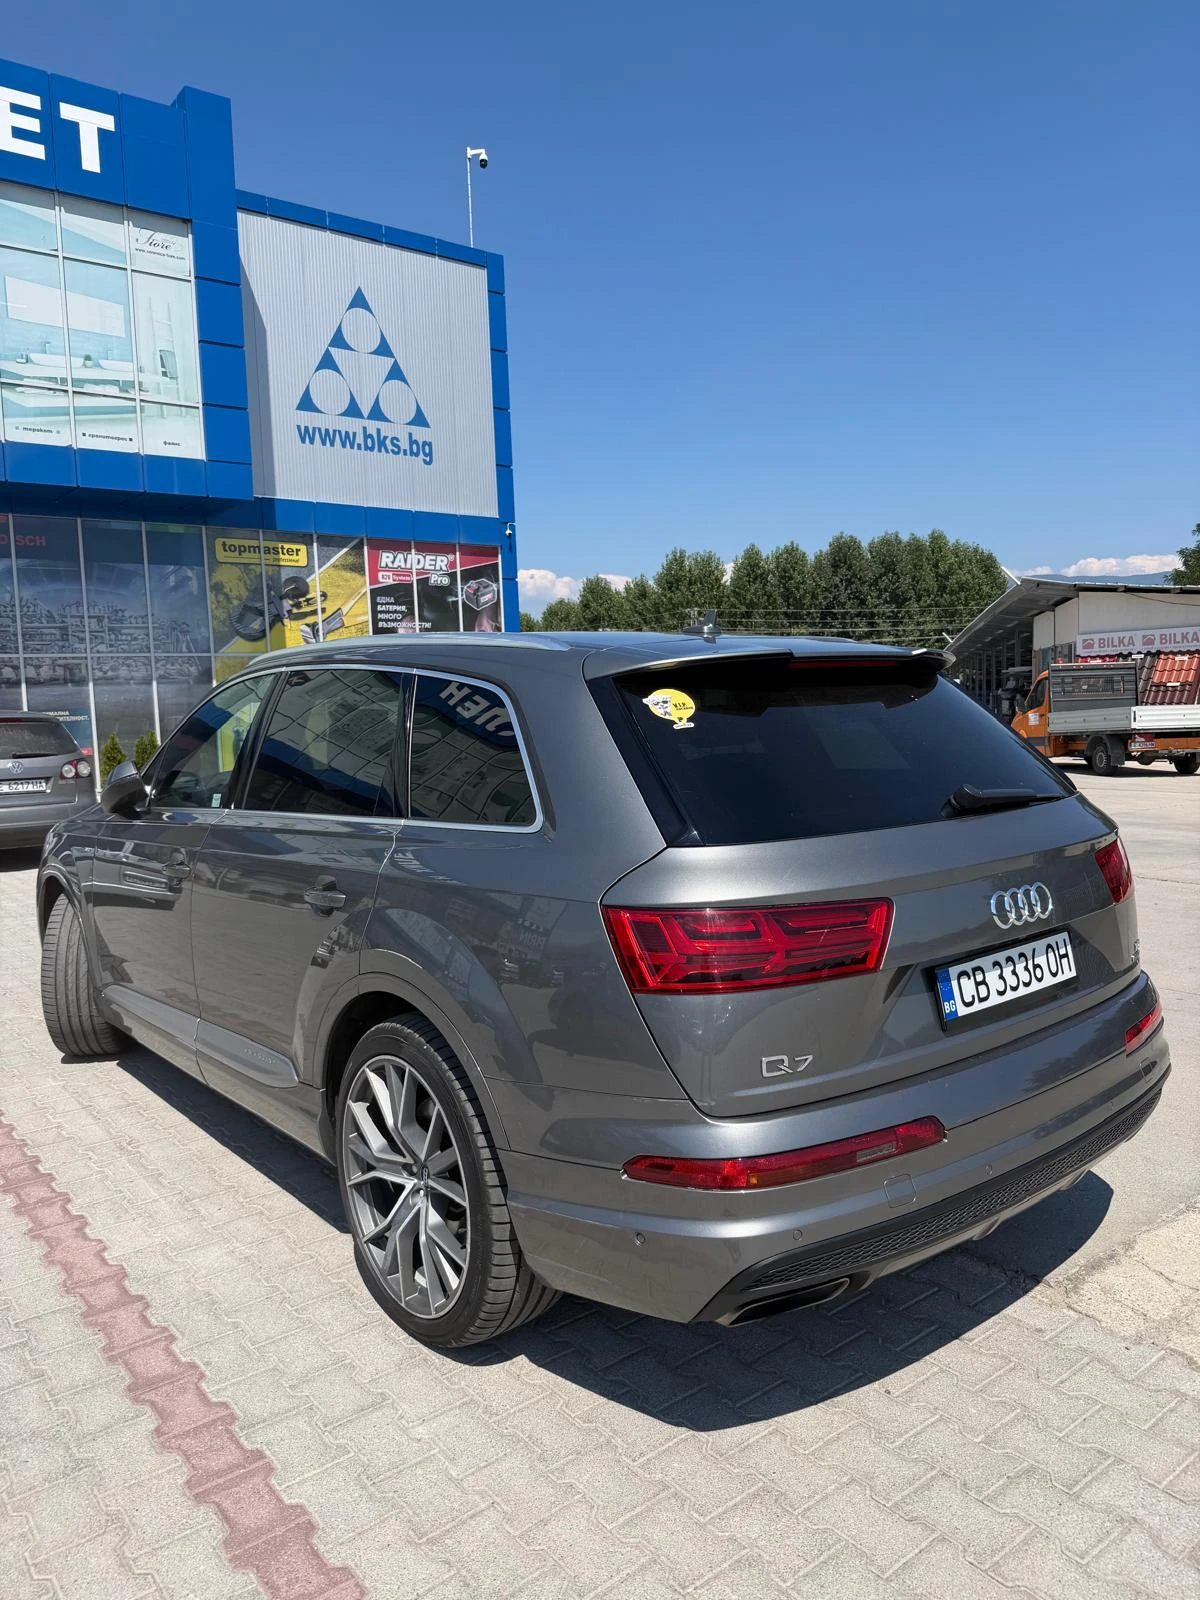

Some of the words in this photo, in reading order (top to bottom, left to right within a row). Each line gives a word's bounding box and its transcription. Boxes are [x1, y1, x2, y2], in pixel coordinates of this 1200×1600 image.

[296, 424, 434, 466] www.bks.bg
[221, 541, 301, 557] topmaster
[379, 551, 449, 571] RAIDER
[430, 573, 449, 585] Pro
[376, 604, 408, 613] БАТЕРИЯ,
[377, 621, 432, 629] ВЪЗМОЖНОСТИ!
[1098, 635, 1136, 648] BILKA
[1159, 631, 1200, 645] BILKA
[8, 781, 31, 791] 6217
[956, 965, 991, 1009] CB
[994, 951, 1046, 998] 3336
[1045, 938, 1073, 980] OH
[943, 999, 957, 1014] BG
[760, 1053, 814, 1079] Q7
